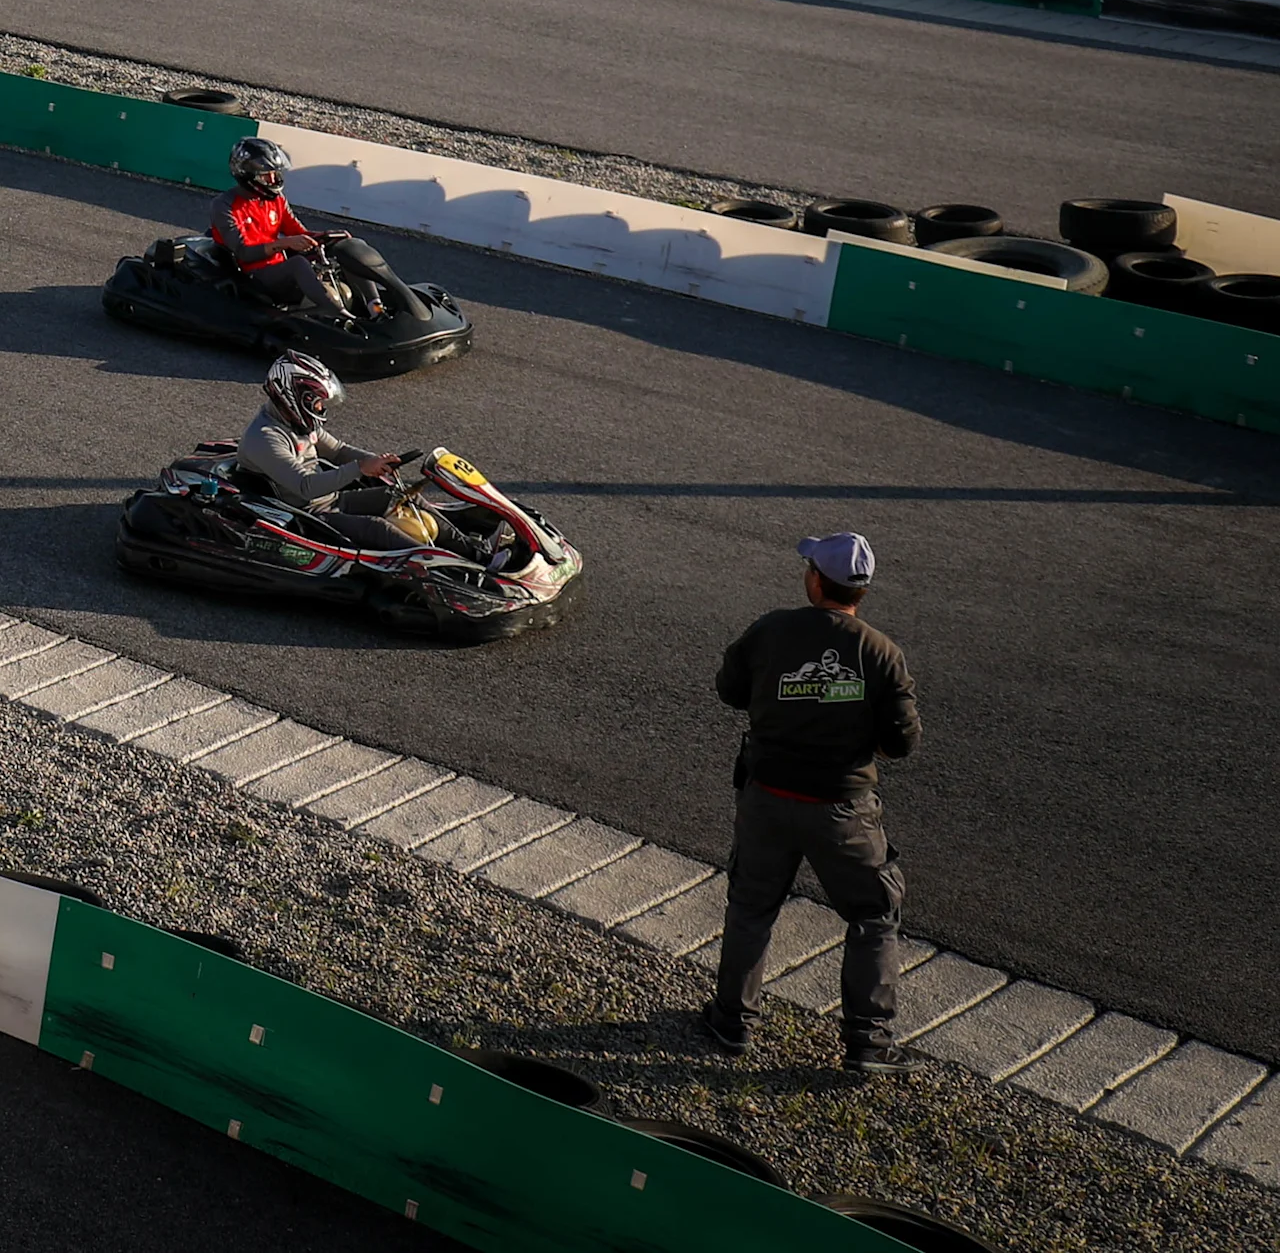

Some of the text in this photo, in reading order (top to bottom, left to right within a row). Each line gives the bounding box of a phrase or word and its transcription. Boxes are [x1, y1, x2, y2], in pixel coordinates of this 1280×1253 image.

[453, 459, 475, 476] 12
[783, 683, 821, 695] KART
[831, 685, 860, 697] FUN
